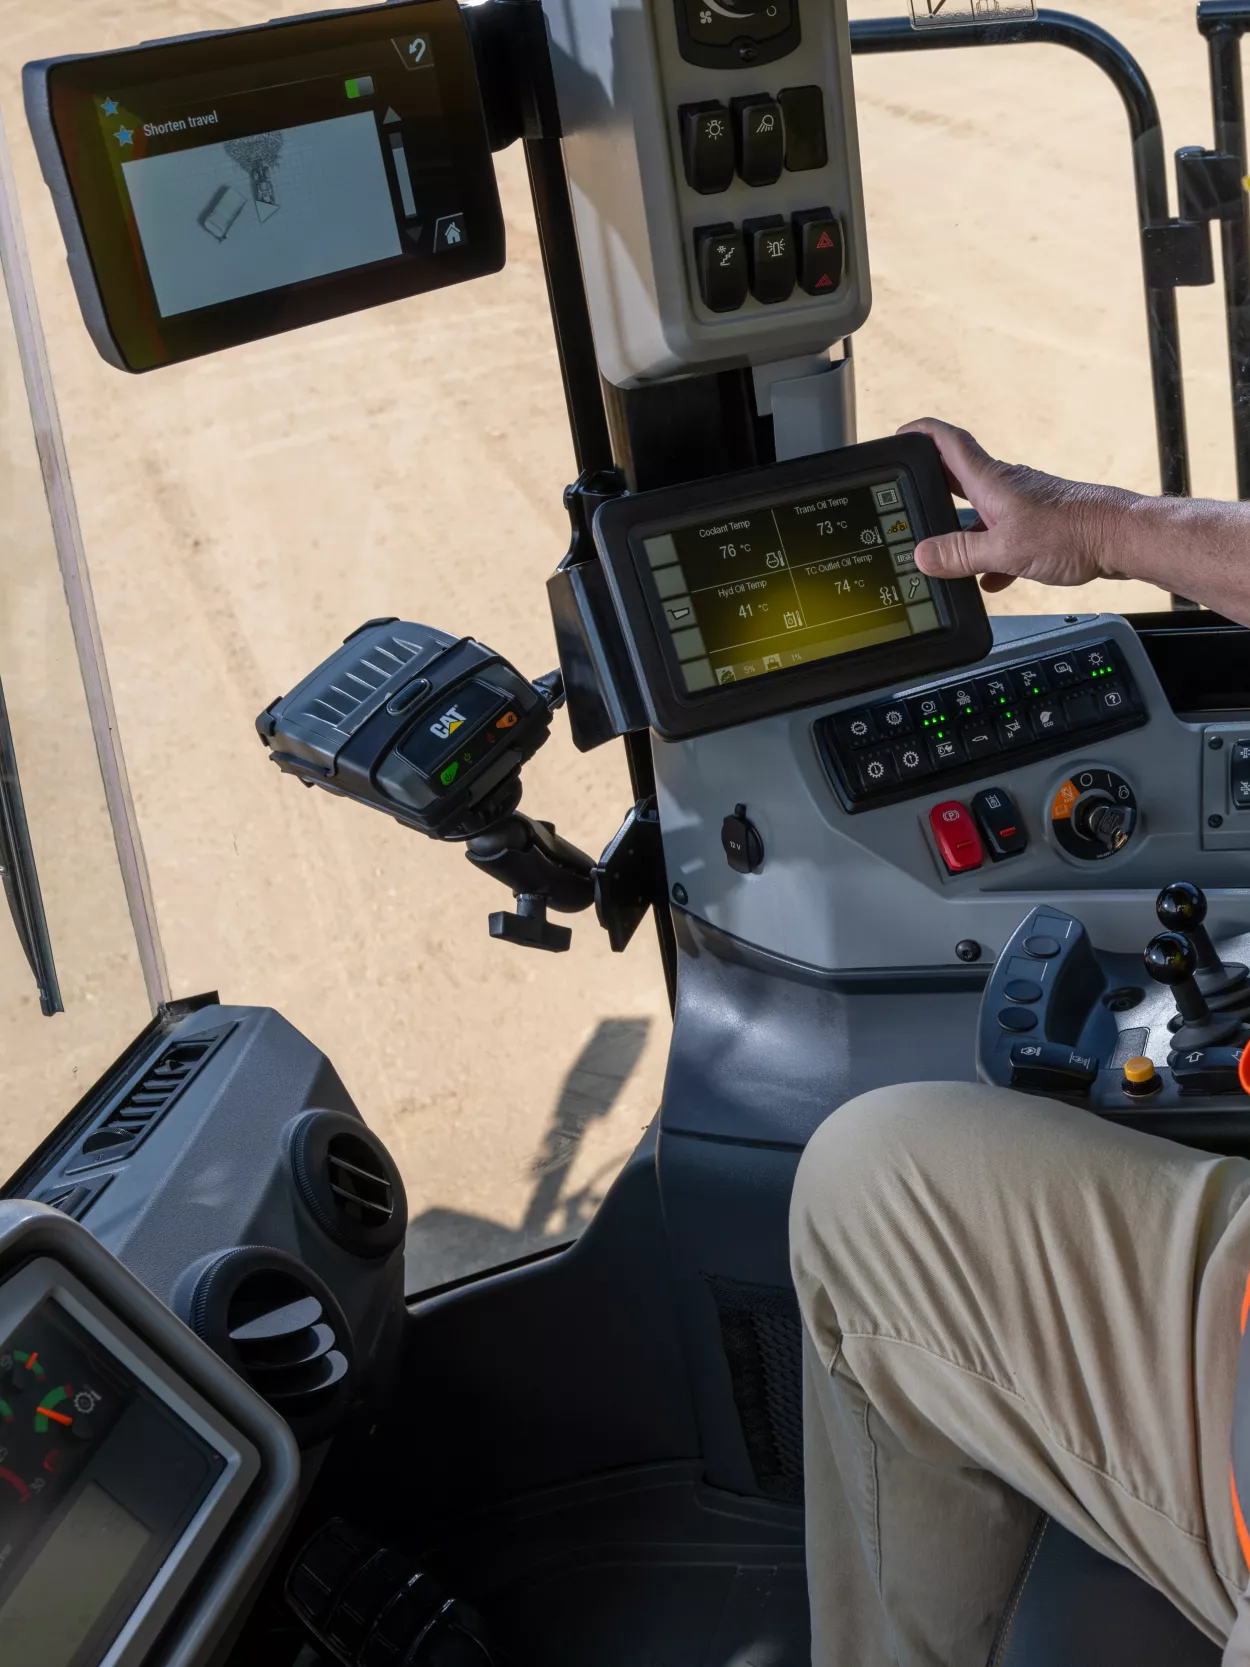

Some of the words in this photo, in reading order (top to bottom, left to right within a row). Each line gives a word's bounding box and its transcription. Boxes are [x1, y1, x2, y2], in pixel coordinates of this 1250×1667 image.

[143, 120, 187, 137] Shorten
[188, 109, 219, 128] travel
[794, 503, 816, 515] Trans
[816, 500, 828, 510] Oil
[828, 496, 849, 507] Temp
[699, 524, 729, 538] Coolant
[728, 519, 751, 532] Temp
[816, 520, 834, 536] 73
[719, 543, 737, 559] 76
[805, 565, 818, 576] TC
[818, 560, 841, 573] Outlet
[841, 557, 852, 567] Oil
[852, 553, 873, 564] Temp
[717, 586, 734, 598] Hyd
[734, 583, 746, 593] Oil
[746, 579, 767, 591] Temp
[834, 579, 851, 595] 74
[738, 603, 753, 618] 41
[743, 665, 756, 674] 5%
[429, 706, 467, 739] CAT
